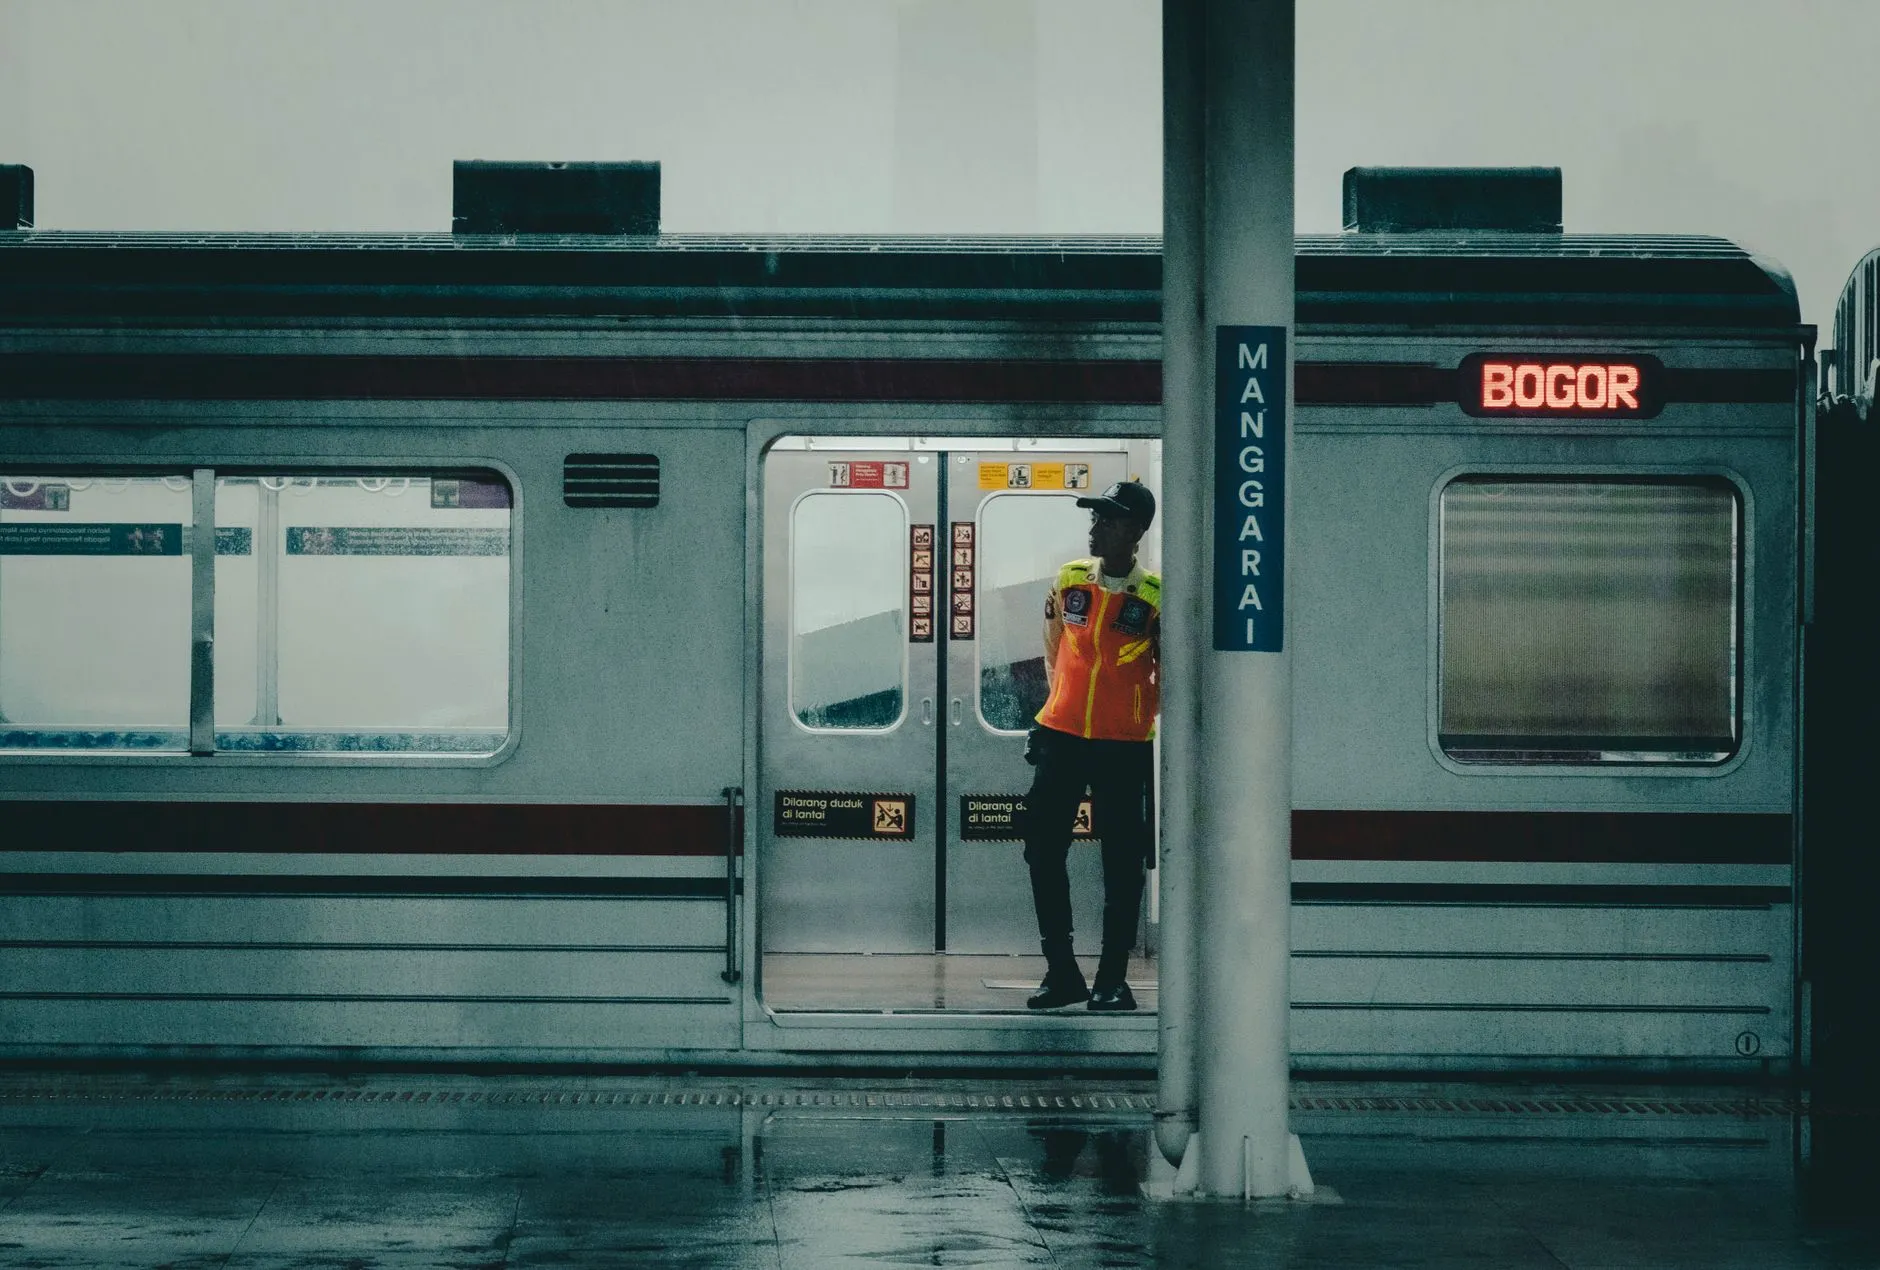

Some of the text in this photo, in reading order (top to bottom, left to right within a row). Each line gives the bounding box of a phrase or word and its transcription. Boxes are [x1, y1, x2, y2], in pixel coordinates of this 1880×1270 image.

[1482, 363, 1640, 409] BOGOR
[1238, 343, 1267, 645] MANGGARAI
[782, 797, 864, 809] Dilarang duduk
[968, 801, 1013, 813] Dilarang
[782, 809, 825, 820] di lantai
[968, 813, 1011, 823] di lantai
